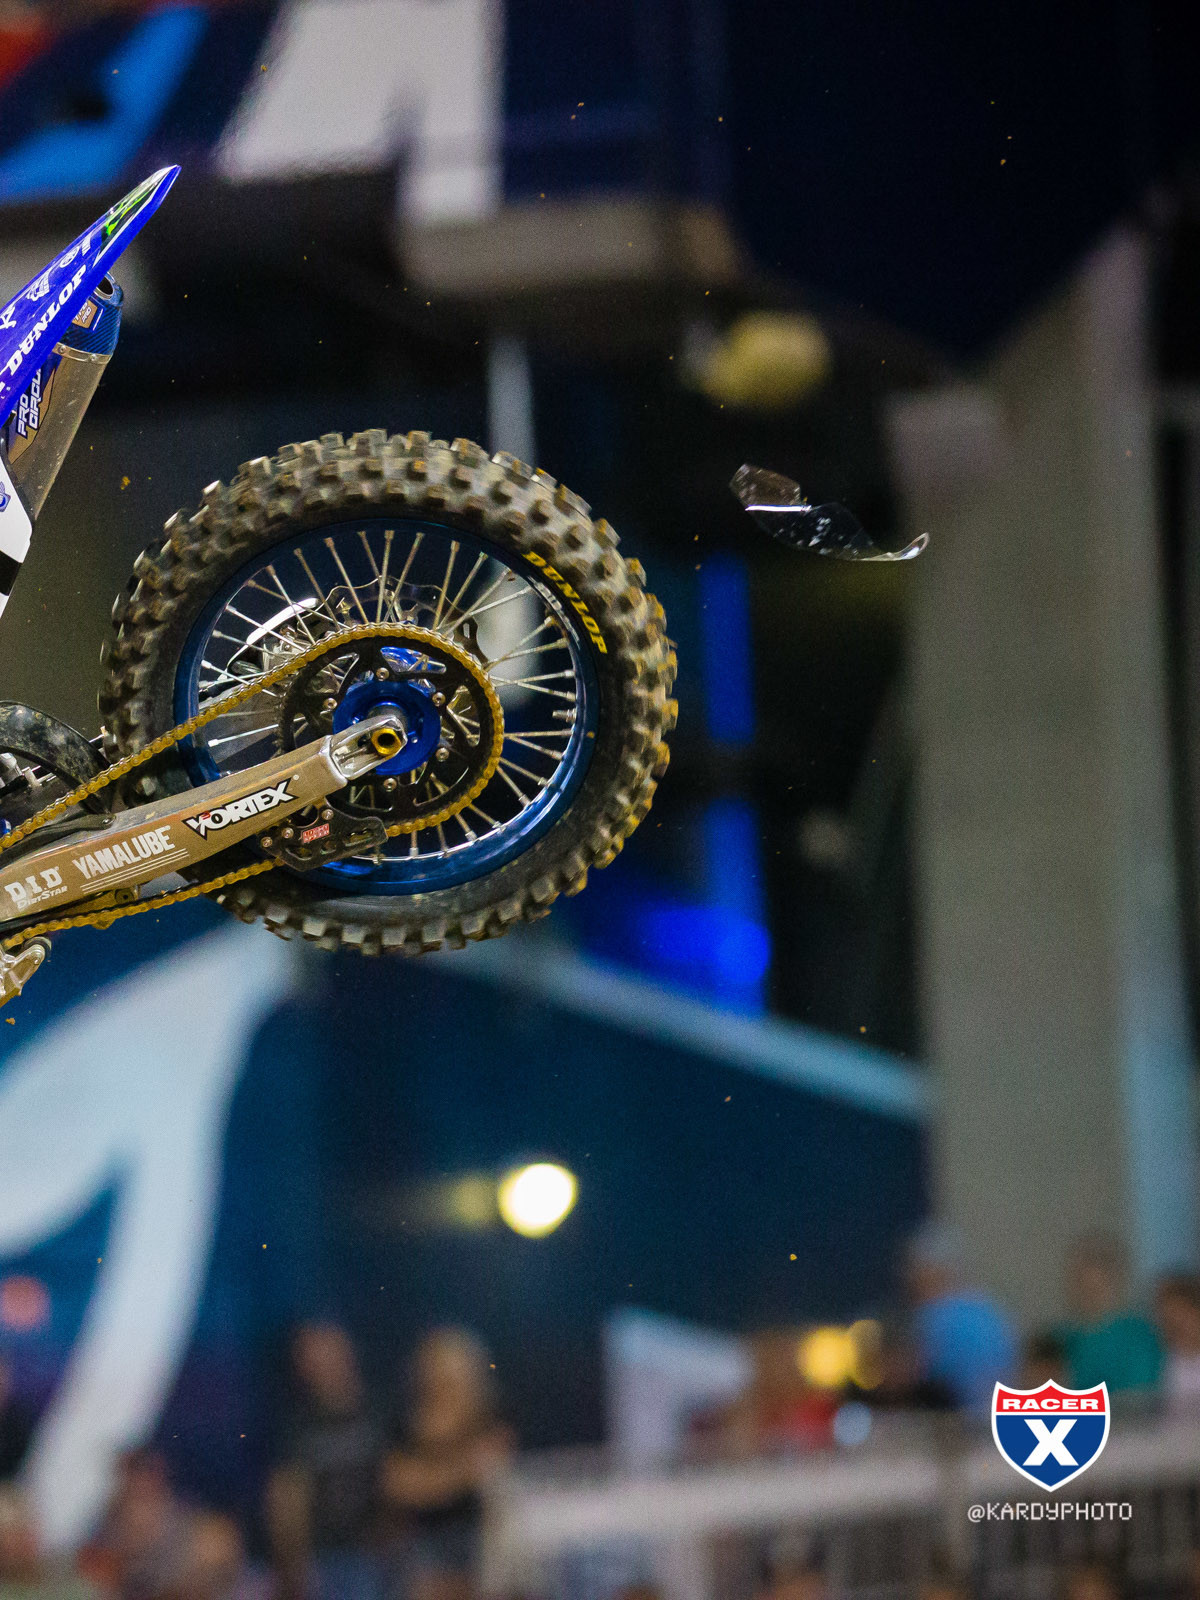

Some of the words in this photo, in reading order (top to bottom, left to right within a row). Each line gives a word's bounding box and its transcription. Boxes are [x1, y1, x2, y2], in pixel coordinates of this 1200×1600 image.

[6, 265, 87, 375] DUNLOP
[17, 393, 30, 438] PRO
[521, 551, 607, 654] DUNLOP
[188, 782, 295, 837] VORTEX
[72, 825, 175, 880] YAMALUBE
